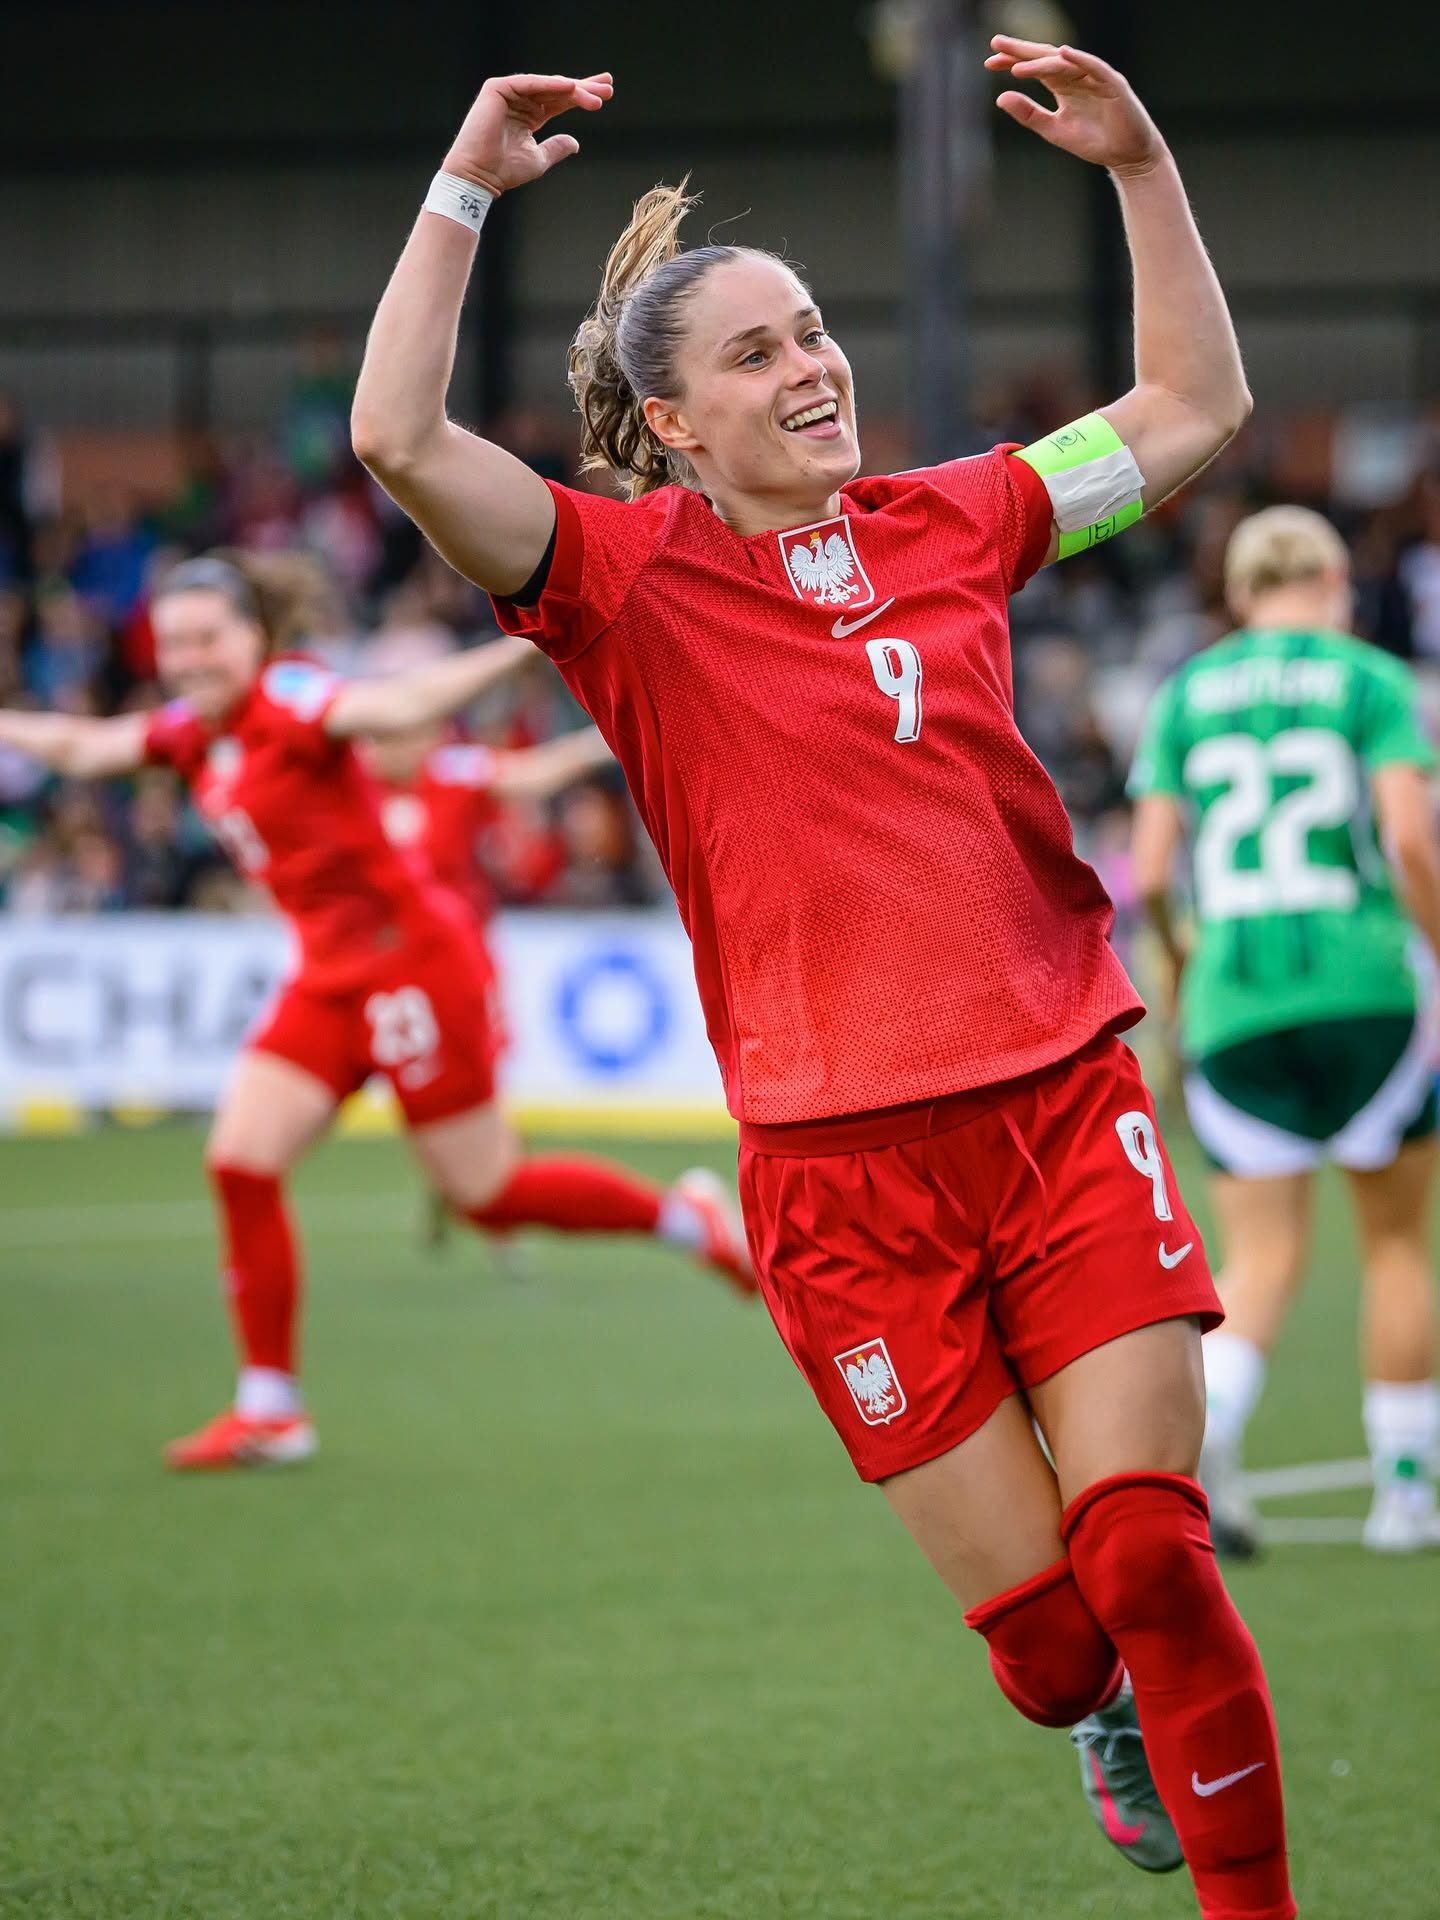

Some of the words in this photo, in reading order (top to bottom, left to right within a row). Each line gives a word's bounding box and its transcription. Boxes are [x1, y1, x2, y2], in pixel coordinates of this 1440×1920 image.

[865, 637, 923, 743] 9
[1184, 728, 1359, 918] 22
[1115, 1111, 1173, 1221] 9
